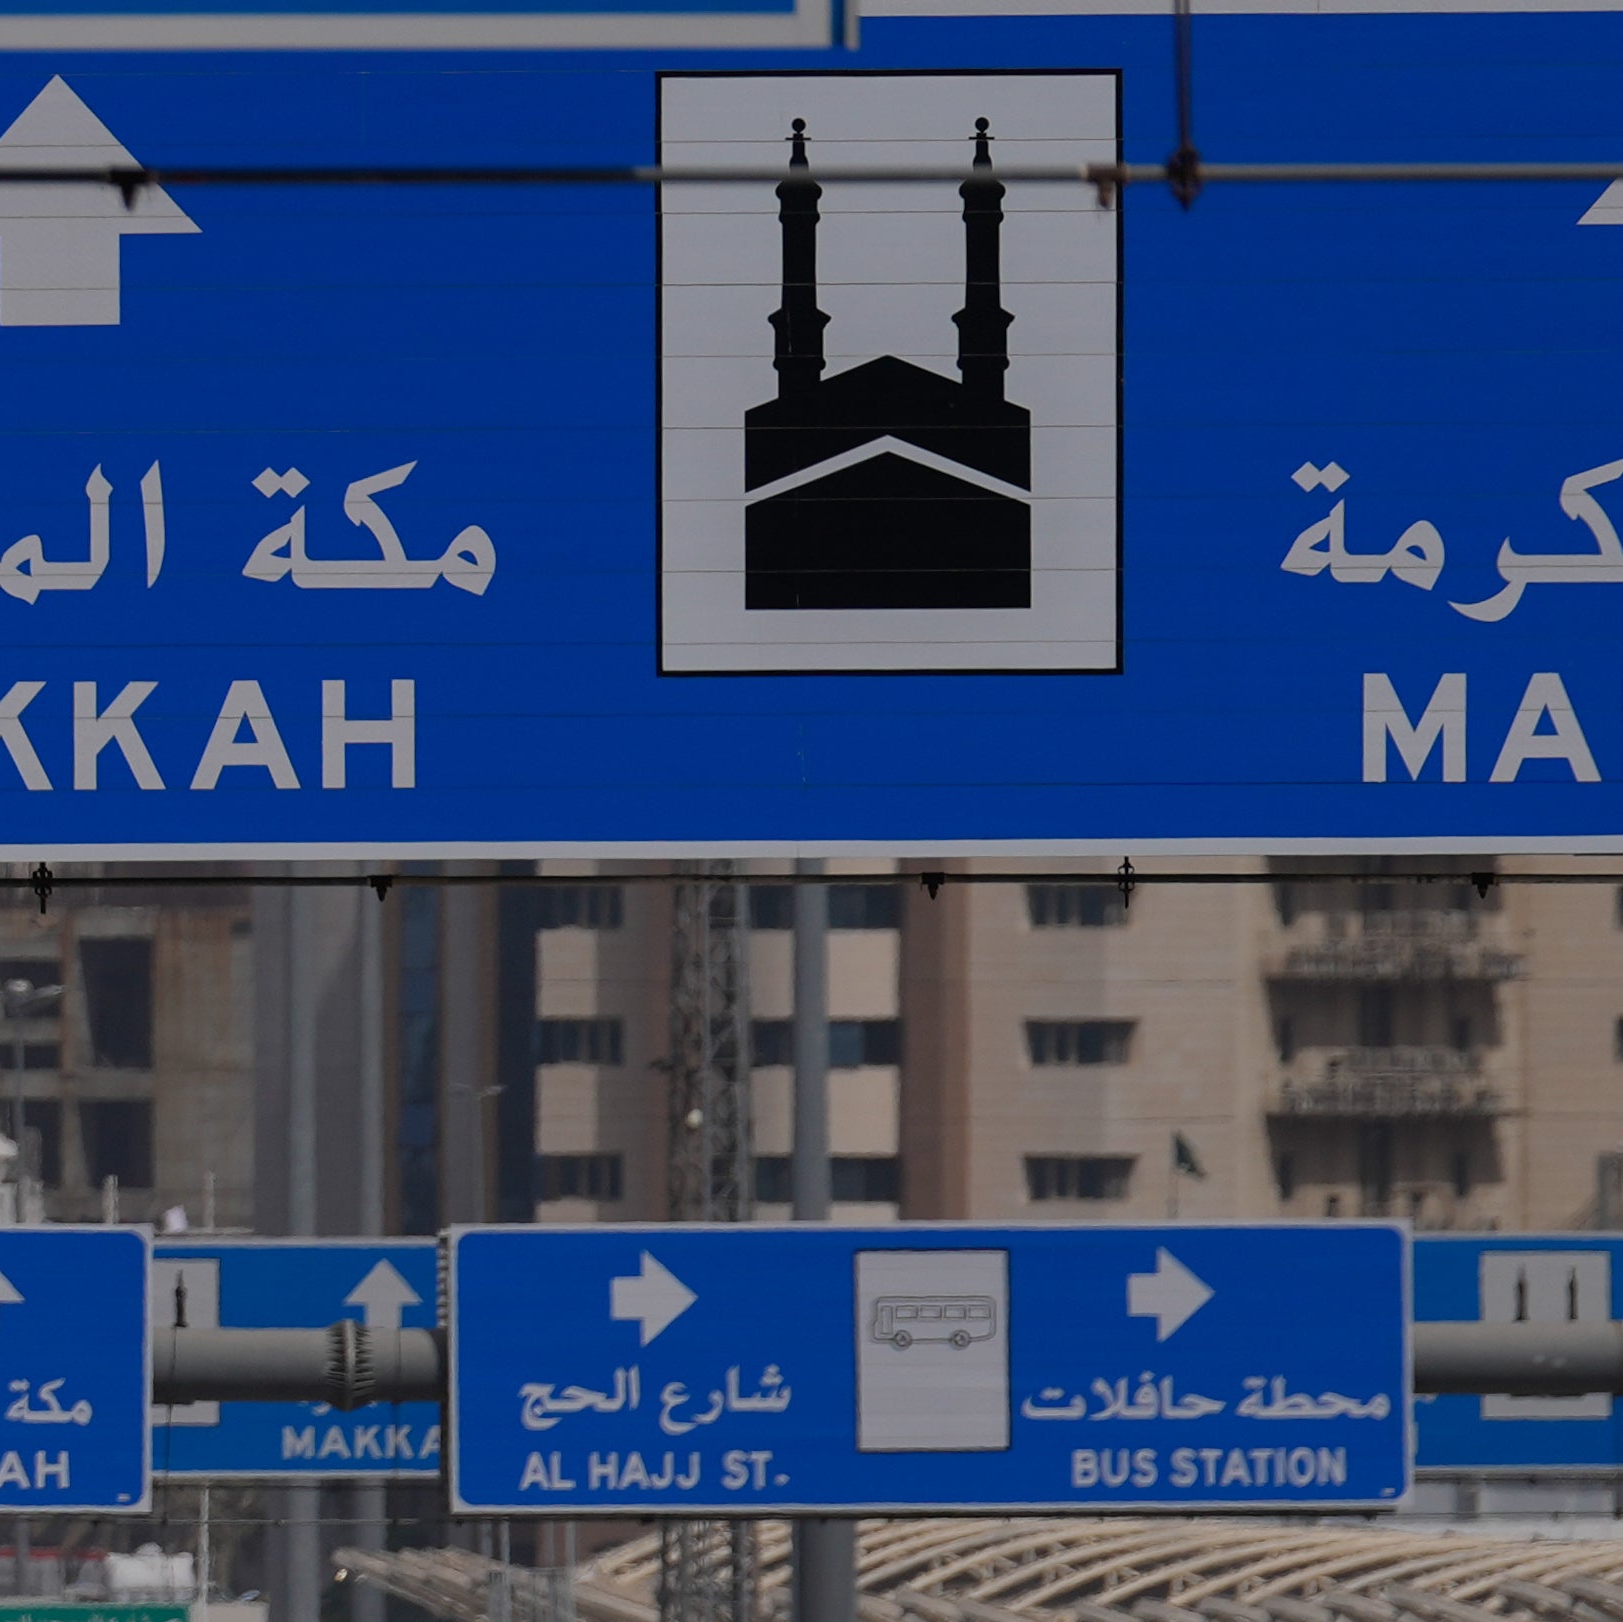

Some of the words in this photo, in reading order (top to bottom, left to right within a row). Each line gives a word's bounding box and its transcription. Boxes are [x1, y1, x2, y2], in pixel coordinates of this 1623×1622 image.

[242, 461, 496, 595] مكة
[7, 1380, 92, 1425] مكة
[521, 1368, 639, 1429] الحج
[661, 1366, 790, 1434] شارع
[1023, 1373, 1223, 1420] حافلات
[1238, 1378, 1389, 1418] محطة
[521, 1452, 575, 1489] AL
[590, 1453, 699, 1488] HAJJ
[723, 1451, 788, 1489] ST.
[1073, 1449, 1156, 1486] BUS
[1172, 1448, 1345, 1486] STATION
